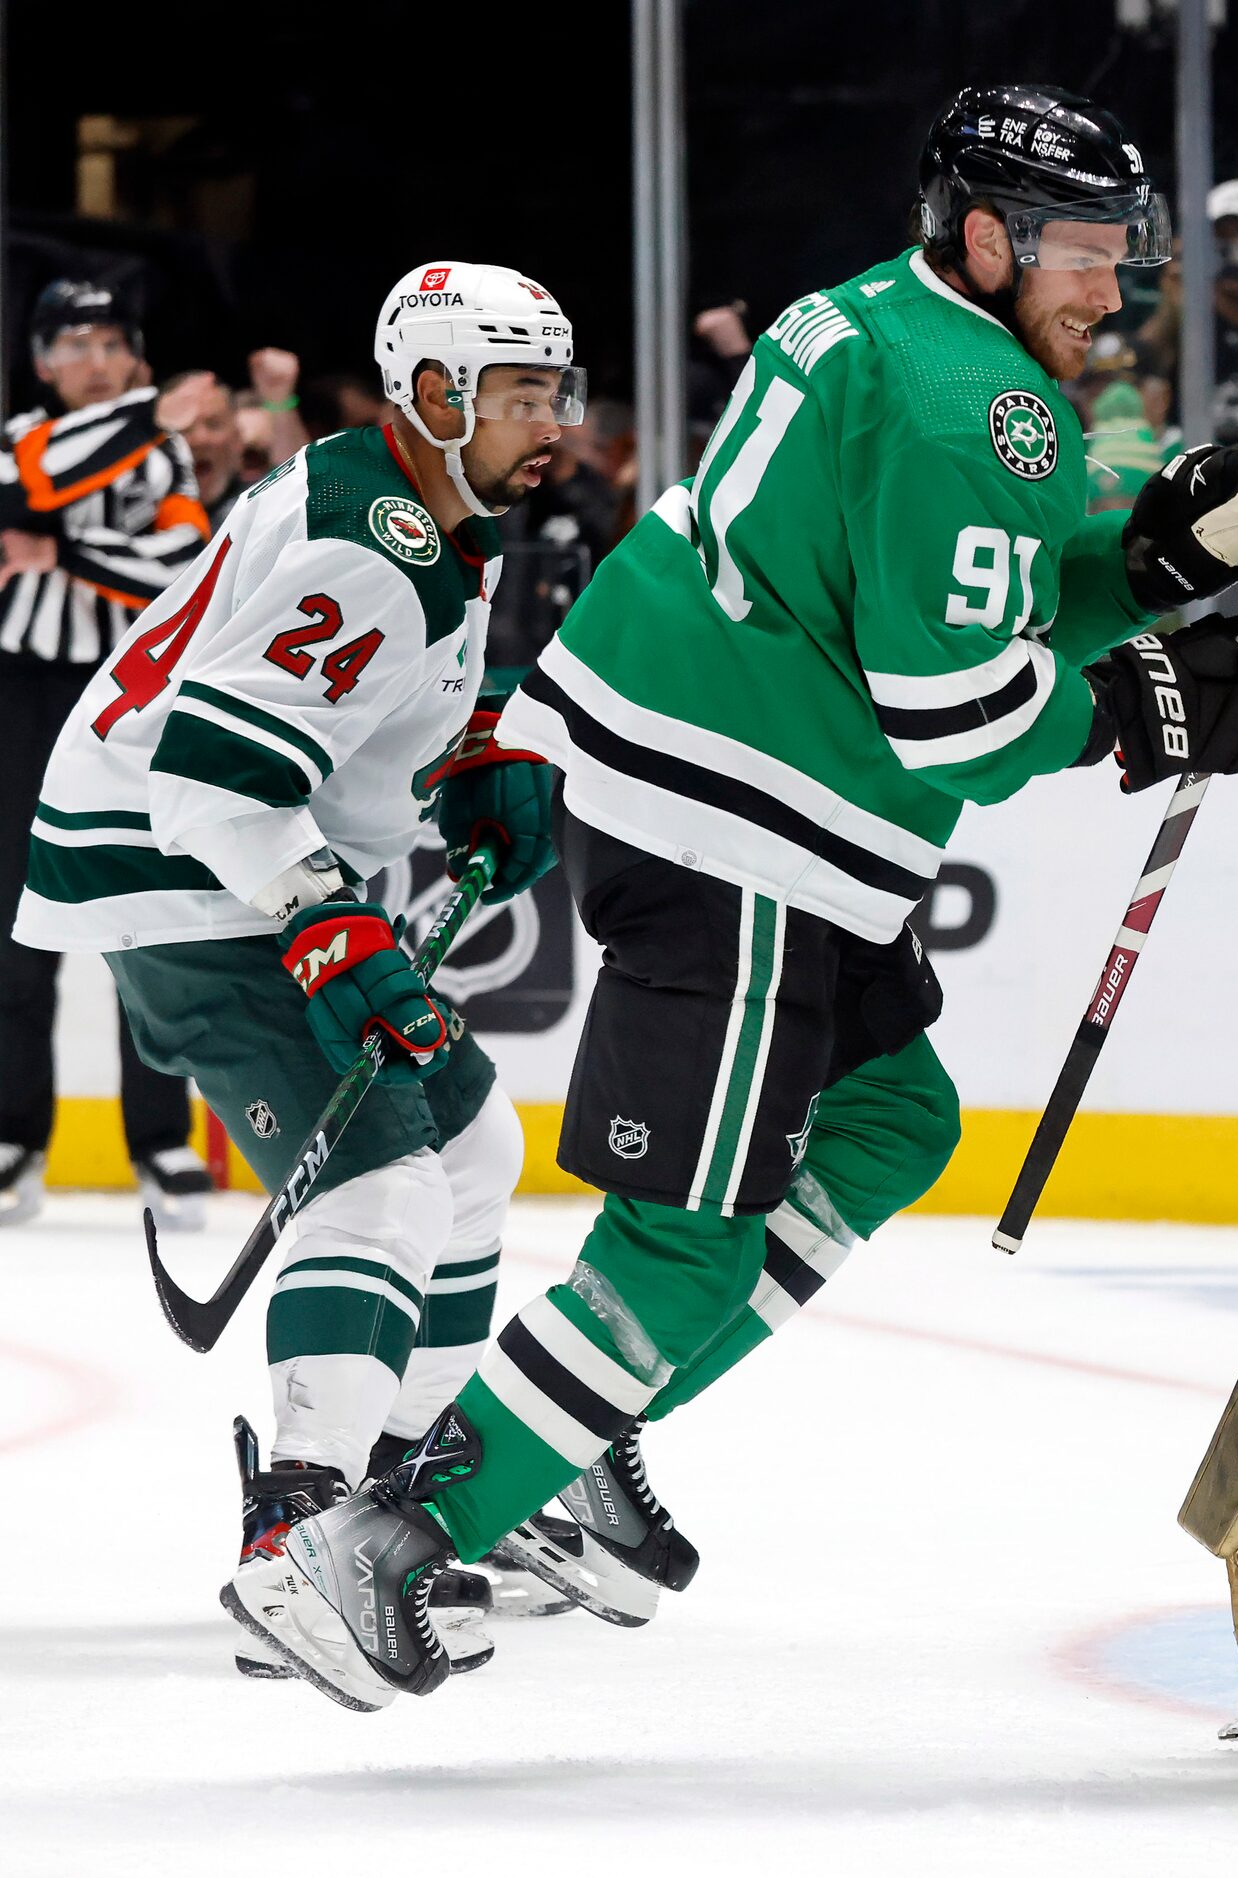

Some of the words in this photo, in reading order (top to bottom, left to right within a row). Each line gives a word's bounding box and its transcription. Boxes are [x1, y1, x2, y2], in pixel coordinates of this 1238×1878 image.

[399, 293, 465, 309] TOYOTA
[995, 396, 1055, 442] DALLAS
[996, 434, 1051, 474] STARS
[381, 501, 437, 548] MINNESOTA
[381, 531, 413, 557] WILD
[945, 526, 1042, 634] 91
[262, 592, 386, 705] 24
[616, 1130, 641, 1148] NHL
[270, 1130, 330, 1243] CCM
[591, 1464, 619, 1526] BAUER
[354, 1535, 381, 1653] VAPOR
[384, 1605, 399, 1660] BAUER
